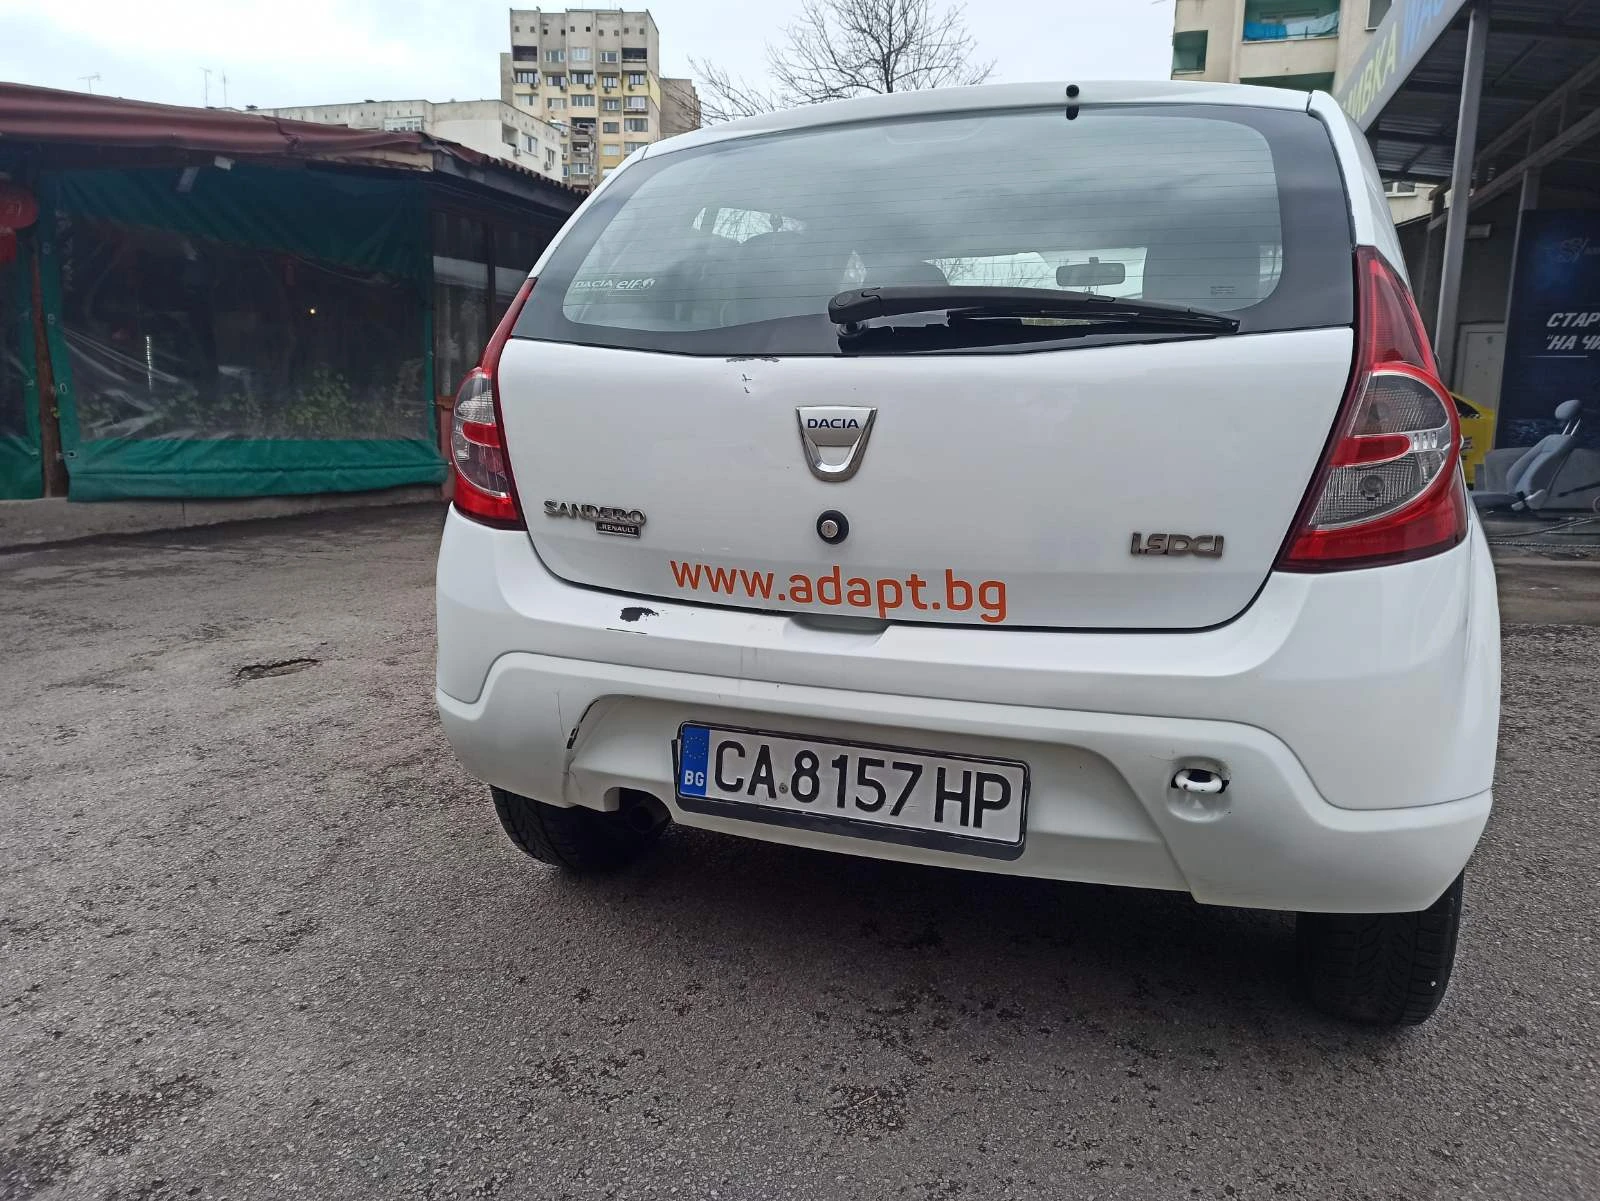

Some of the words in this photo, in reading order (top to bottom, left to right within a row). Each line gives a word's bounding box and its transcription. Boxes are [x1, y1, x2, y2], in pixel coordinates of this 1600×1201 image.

[1343, 20, 1397, 123] ИВКА
[574, 280, 613, 289] DACIA
[1546, 312, 1600, 327] СТАР
[807, 418, 859, 429] DACIA
[543, 499, 647, 526] SANDERO
[601, 524, 636, 534] RENAULT
[669, 559, 1007, 624] www.adapt.bg
[684, 770, 705, 787] BG
